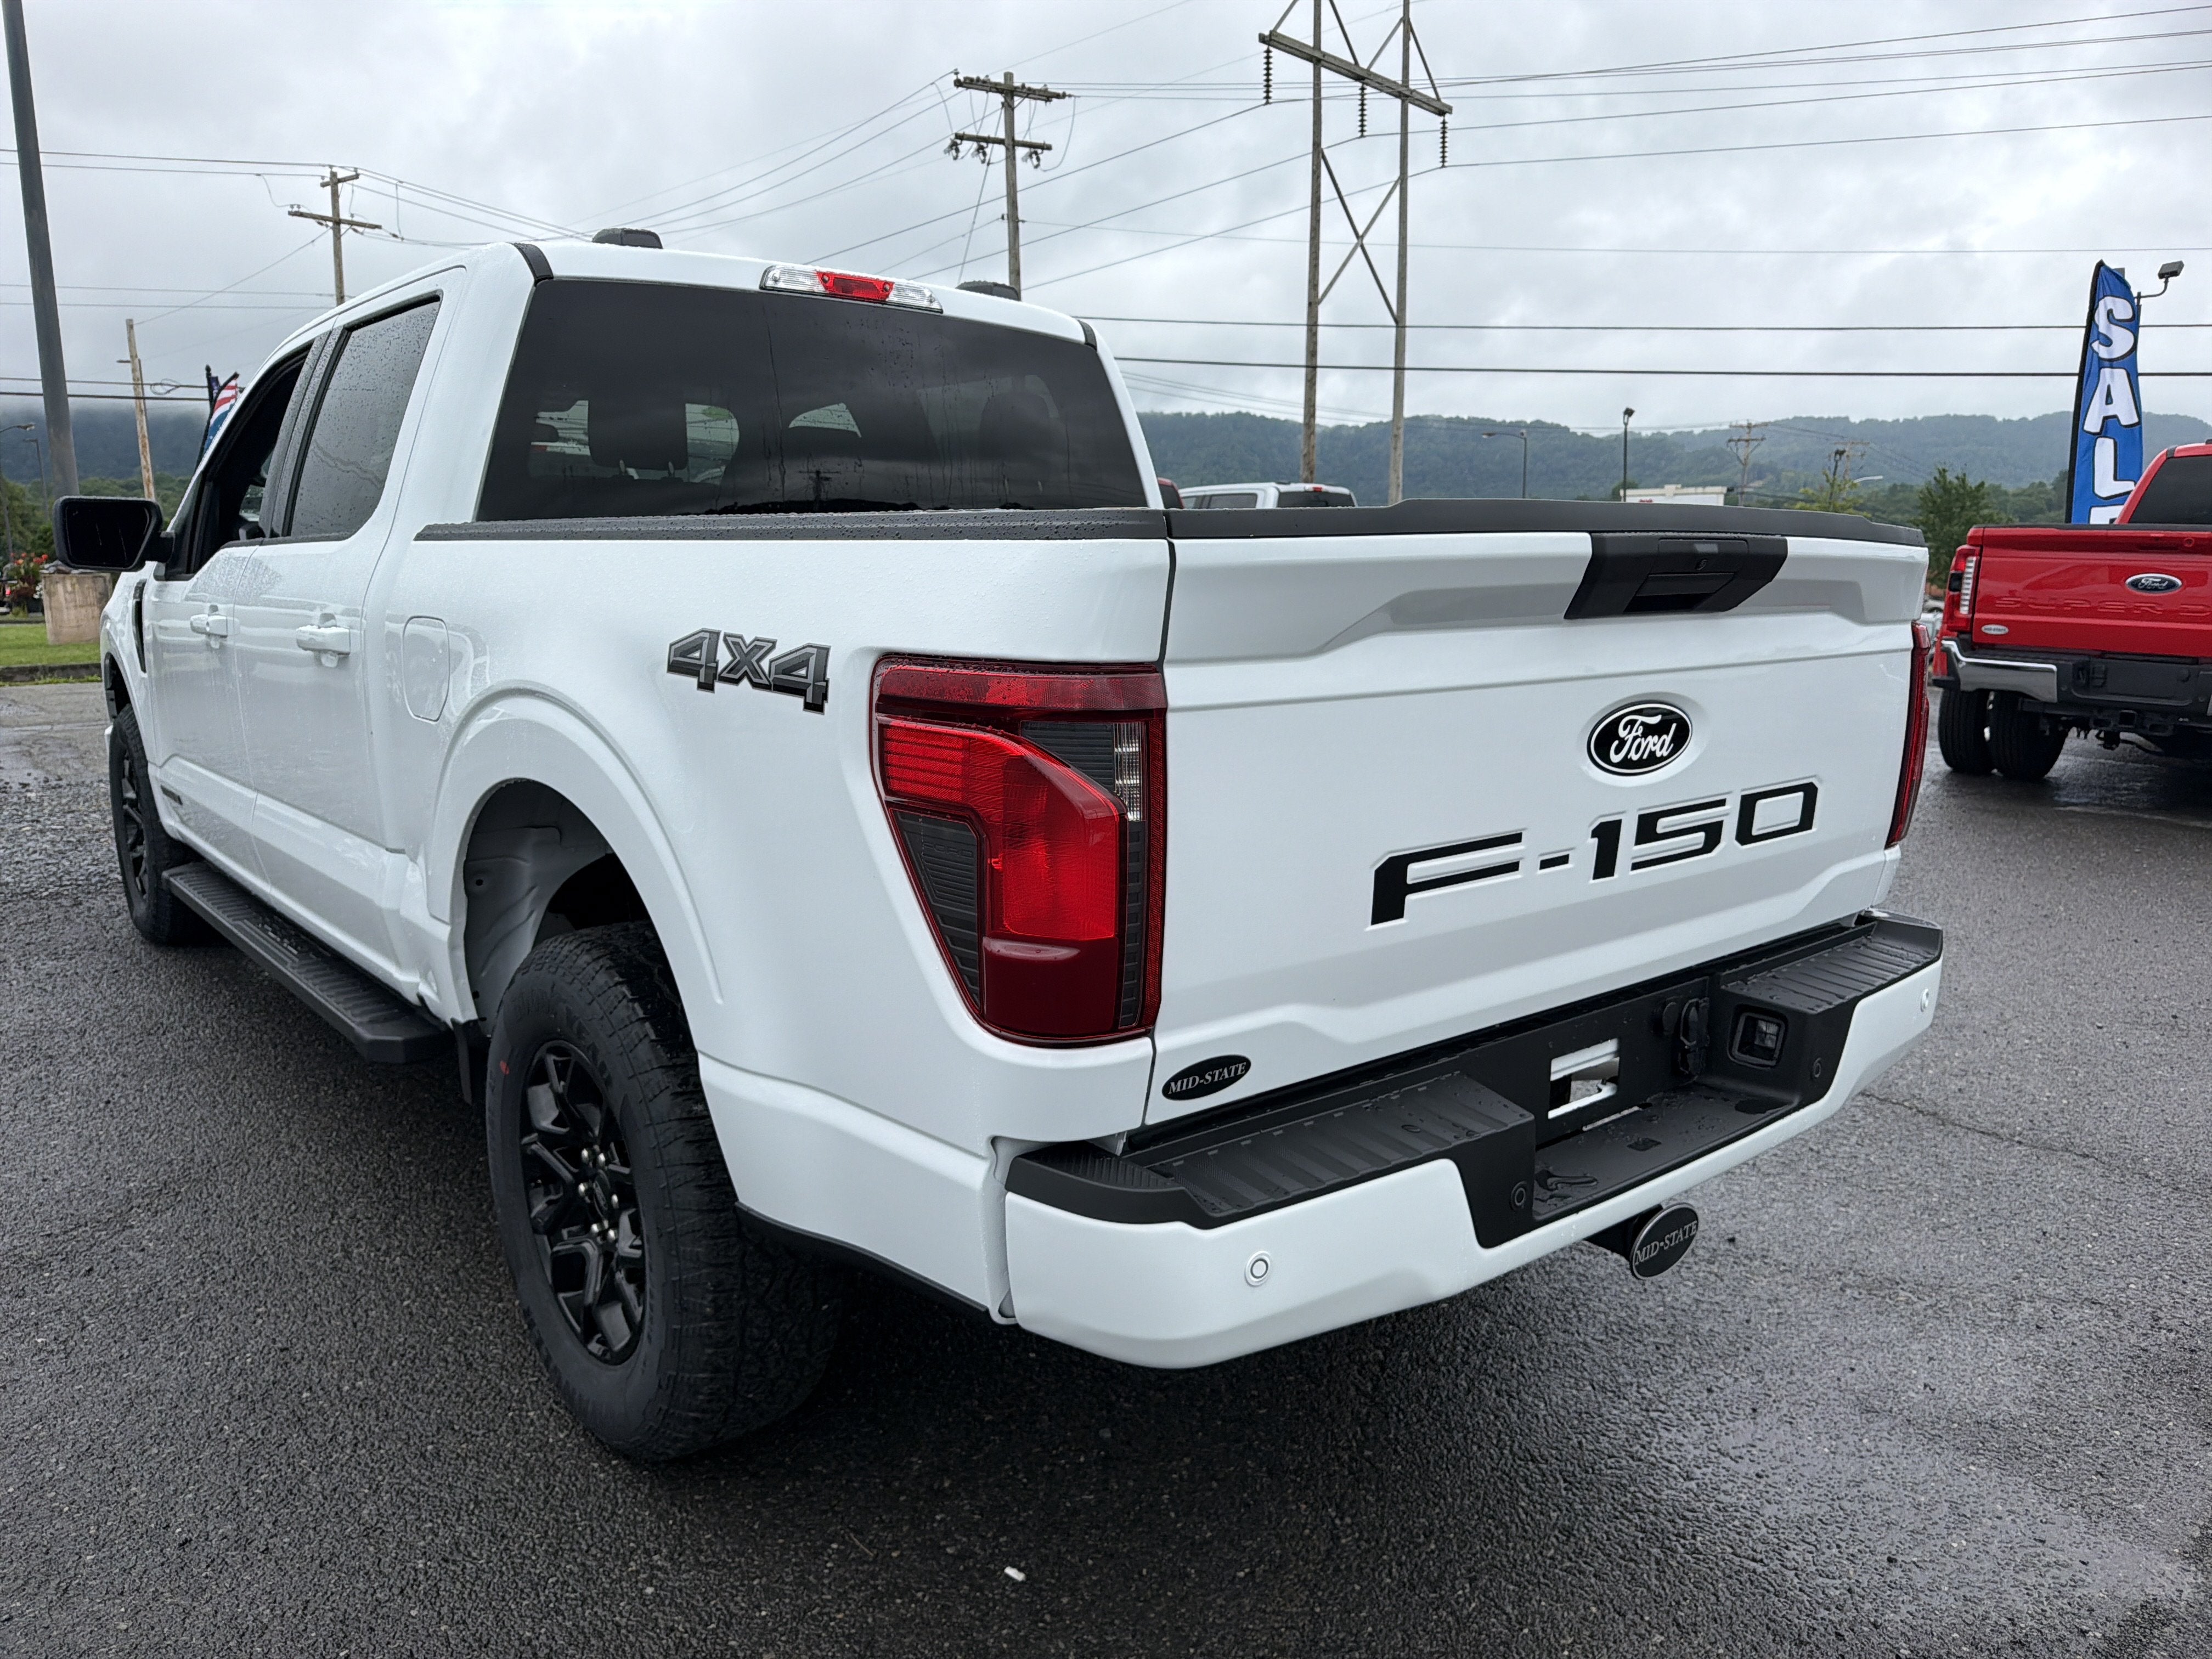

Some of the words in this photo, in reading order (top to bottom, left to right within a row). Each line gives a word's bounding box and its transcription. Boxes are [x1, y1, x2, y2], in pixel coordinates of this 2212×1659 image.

[2138, 577, 2169, 590] Ford
[1609, 714, 1677, 763] Ford
[922, 840, 974, 860] FORD
[1369, 780, 1820, 927] F-150
[1167, 1062, 1246, 1094] MID-STATE
